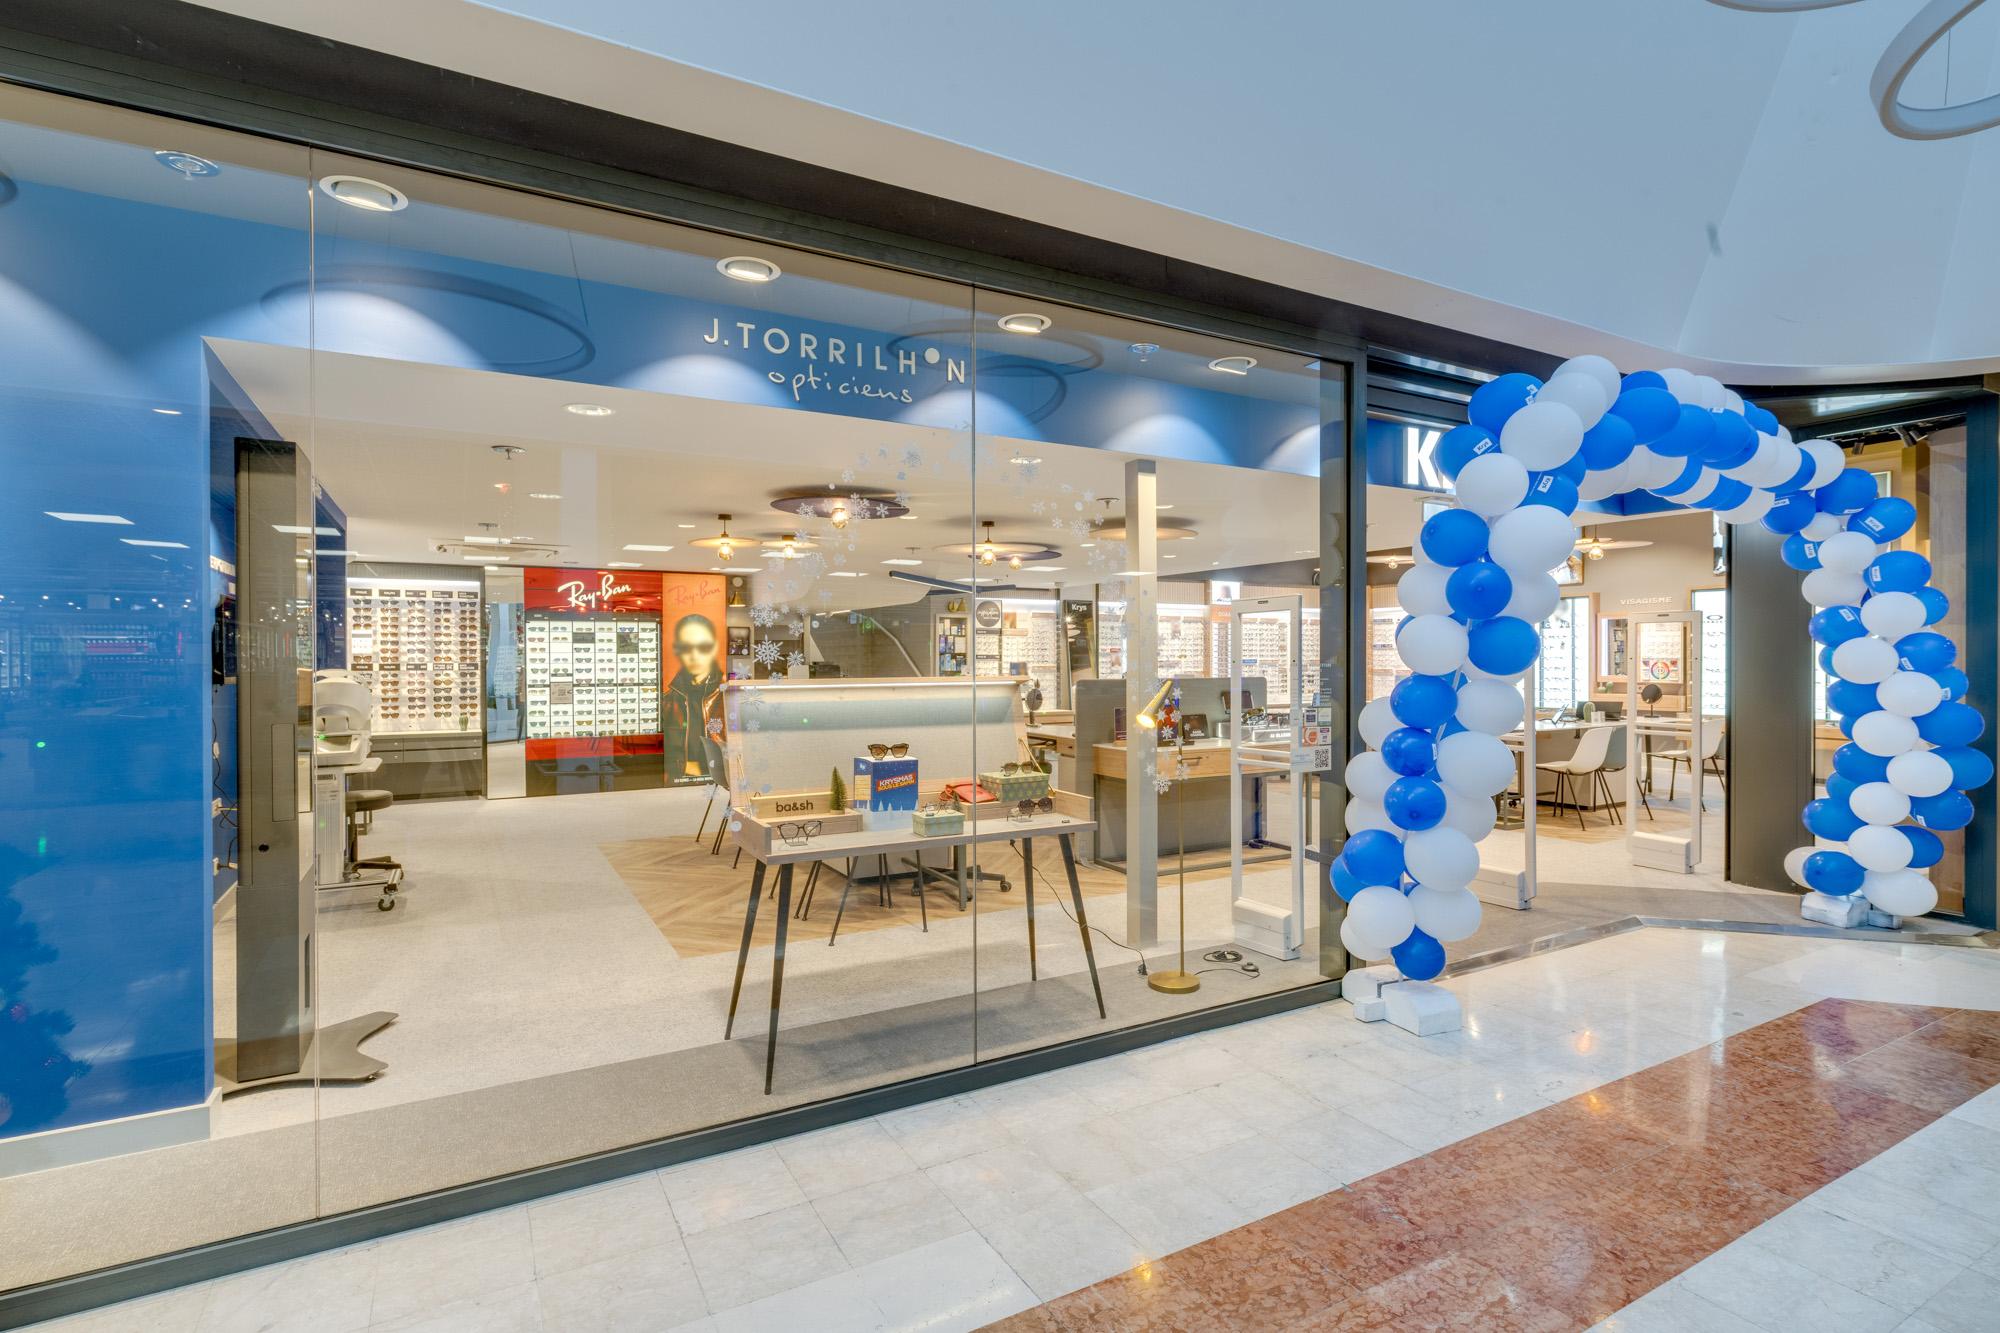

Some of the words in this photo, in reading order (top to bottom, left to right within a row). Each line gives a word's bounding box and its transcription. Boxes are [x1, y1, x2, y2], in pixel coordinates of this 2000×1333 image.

[767, 364, 913, 404] opticiens
[1407, 427, 1455, 490] K
[558, 574, 632, 608] Ray-Ban
[1072, 603, 1087, 612] Krys
[1620, 596, 1673, 605] VISAGISME
[879, 774, 913, 787] KRYSMAS
[776, 799, 814, 813] ba&sh
